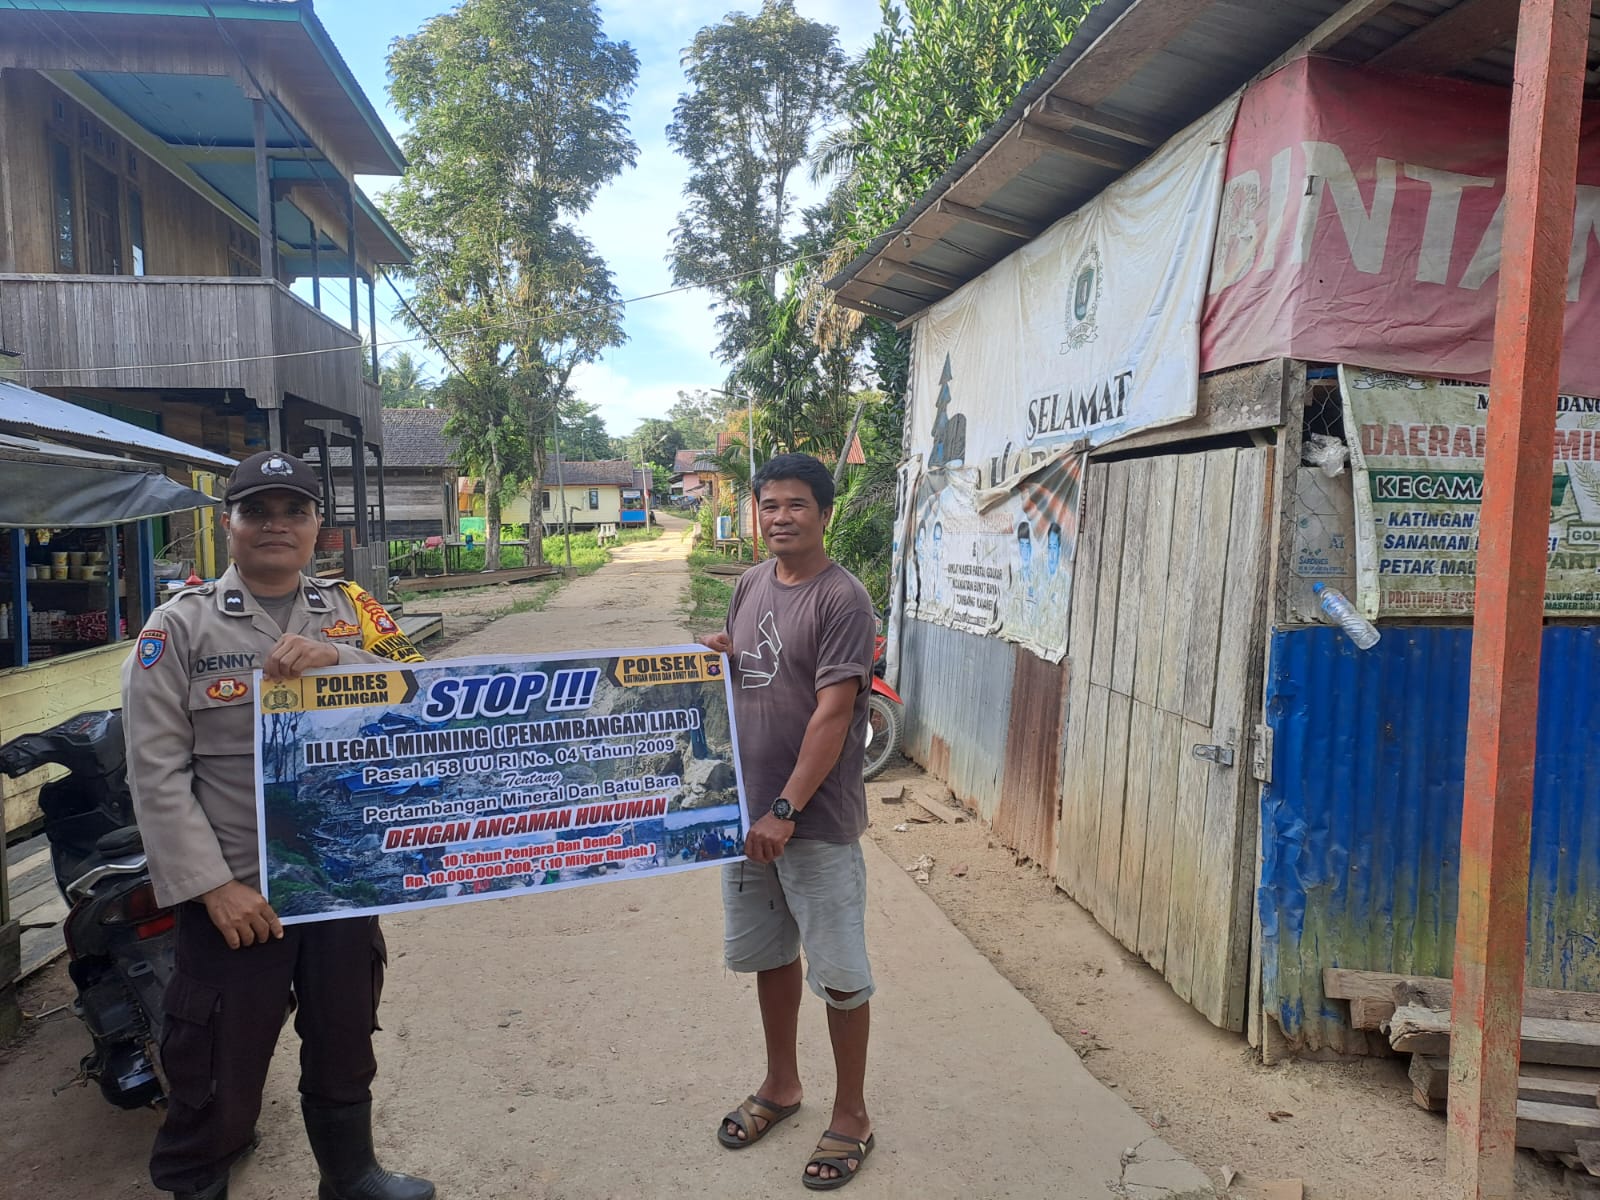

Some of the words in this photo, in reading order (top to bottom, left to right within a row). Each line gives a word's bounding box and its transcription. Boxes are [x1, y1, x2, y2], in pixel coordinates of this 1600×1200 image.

[1027, 371, 1133, 441] SELAMAT
[1388, 512, 1475, 528] KATINGAN
[1384, 534, 1470, 550] SANAMAN
[1379, 559, 1437, 575] PETAK
[196, 653, 256, 674] DENNY
[623, 655, 698, 675] POLSEK
[316, 673, 388, 694] POLRES
[427, 674, 546, 719] STOP
[550, 670, 599, 708] !!!
[316, 690, 389, 708] KATINGAN
[306, 736, 390, 764] ILLEGAL
[396, 729, 488, 757] MINNING
[365, 764, 419, 783] Pasal
[426, 760, 459, 778] 158
[465, 756, 492, 772] UU
[500, 754, 517, 769] RI
[523, 751, 551, 767] No.
[557, 749, 578, 763] 04
[583, 743, 633, 760] Tahun
[638, 739, 675, 755] 2009
[504, 771, 561, 787] Tentang
[365, 798, 497, 823] Pertambangan
[503, 788, 563, 806] Mineral
[568, 785, 600, 799] Dan
[605, 779, 640, 794] Batu
[645, 775, 680, 790] Bara
[385, 821, 472, 850] DENGAN
[472, 810, 573, 840] ANCAMAN
[574, 797, 667, 827] HUKUMAN
[443, 855, 459, 868] 10
[462, 850, 501, 866] Tahun
[505, 844, 555, 860] Penjara
[557, 841, 581, 853] Dan
[583, 834, 622, 849] Denda
[405, 874, 427, 888] Rp.
[565, 852, 604, 867] Milyar
